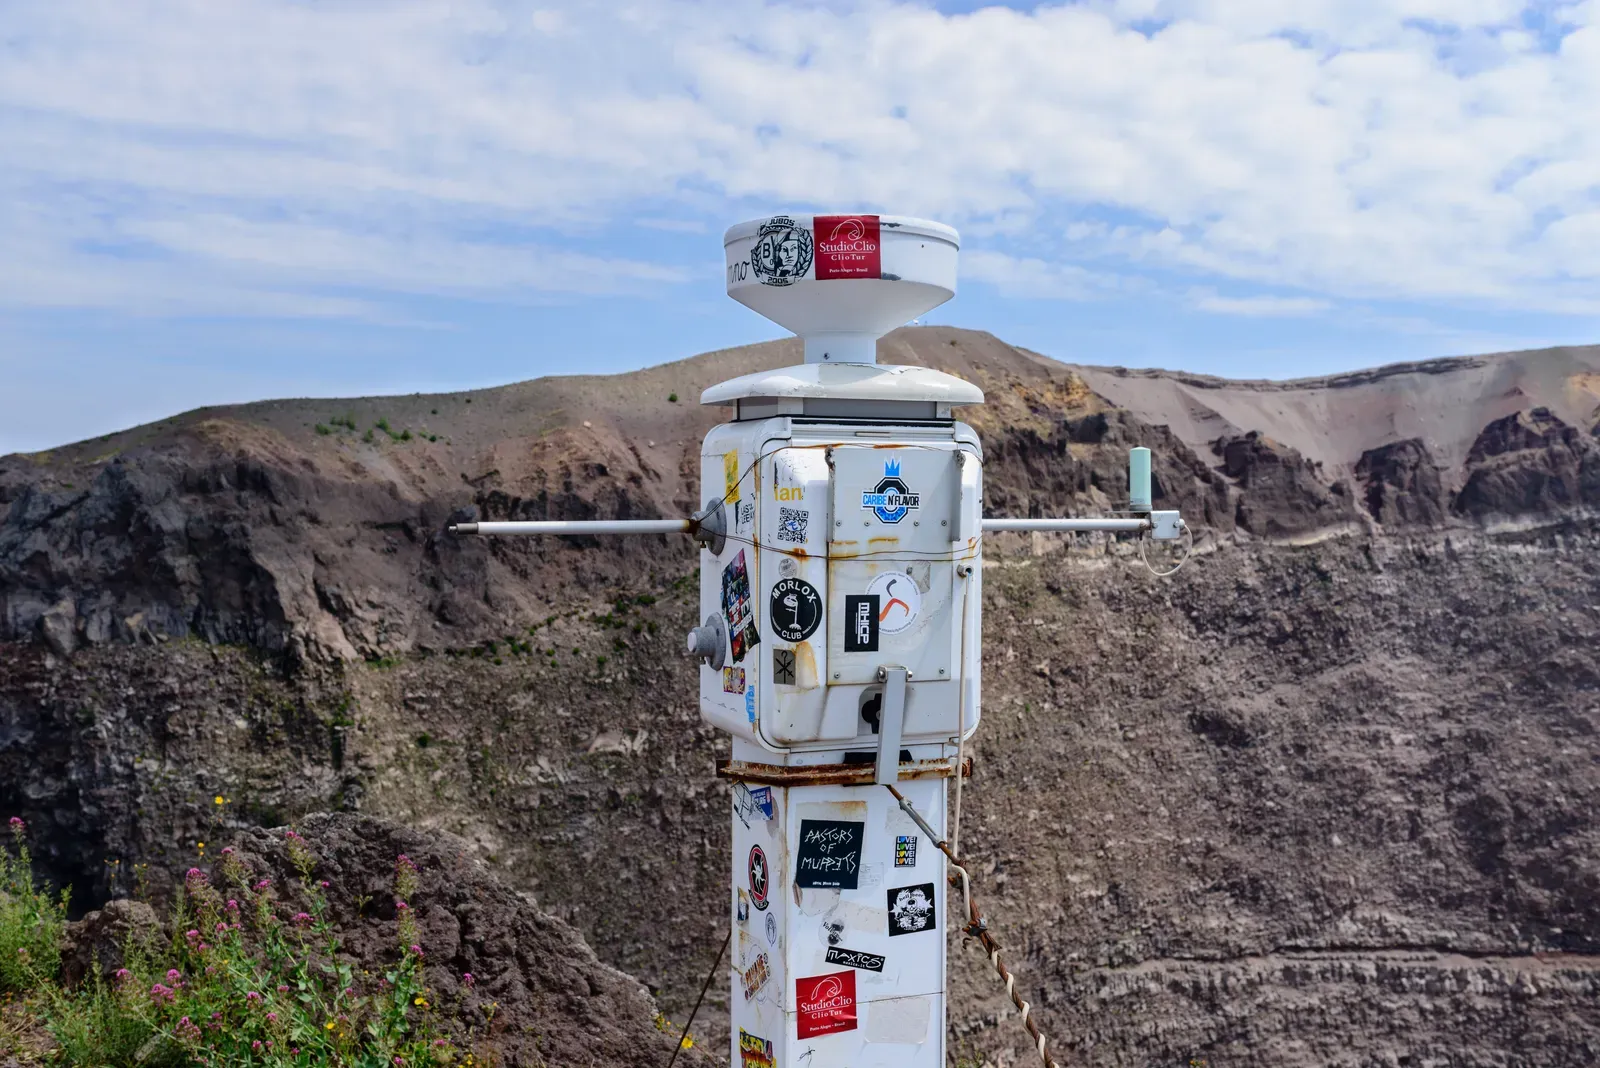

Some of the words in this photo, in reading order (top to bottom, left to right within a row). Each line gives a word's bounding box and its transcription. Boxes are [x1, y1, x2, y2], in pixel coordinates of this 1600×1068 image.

[819, 240, 876, 253] StudioClio
[862, 494, 887, 506] CARIBE
[772, 580, 817, 603] MORLOX
[781, 630, 802, 640] CLUB
[804, 827, 853, 845] PASTORS
[819, 842, 837, 854] OF
[800, 851, 857, 875] MUPPETS
[800, 995, 852, 1013] StudioClio
